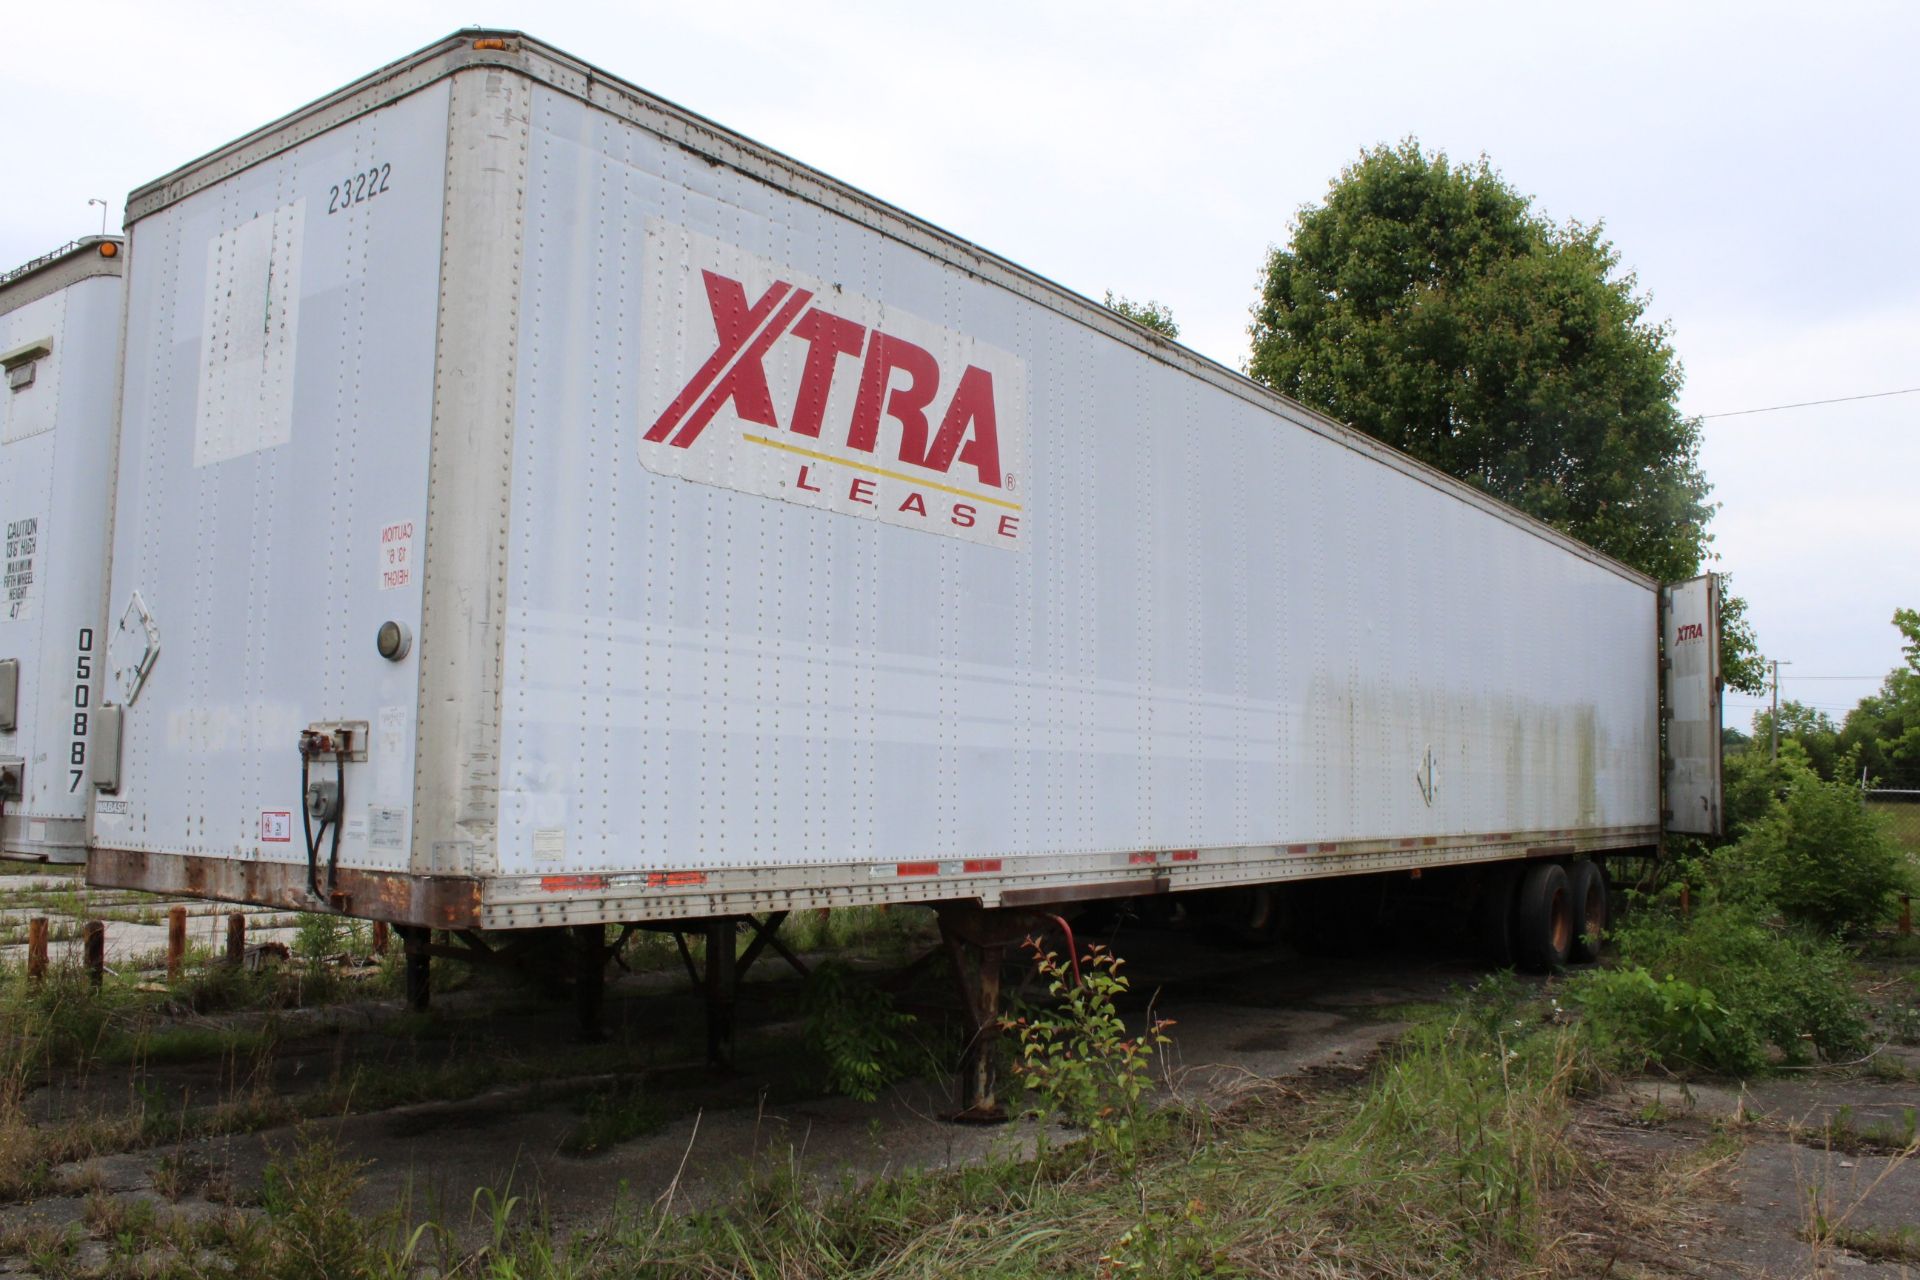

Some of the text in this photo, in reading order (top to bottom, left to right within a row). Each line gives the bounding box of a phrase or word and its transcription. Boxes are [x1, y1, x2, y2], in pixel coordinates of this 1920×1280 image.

[328, 162, 391, 215] 23222
[642, 268, 1002, 489] XTRA
[796, 465, 1020, 539] LEASE
[7, 517, 38, 540] CAUTION
[4, 571, 34, 589] FIFTH WHEEL
[9, 586, 28, 601] HEIGHT
[1675, 623, 1703, 647] XTRA
